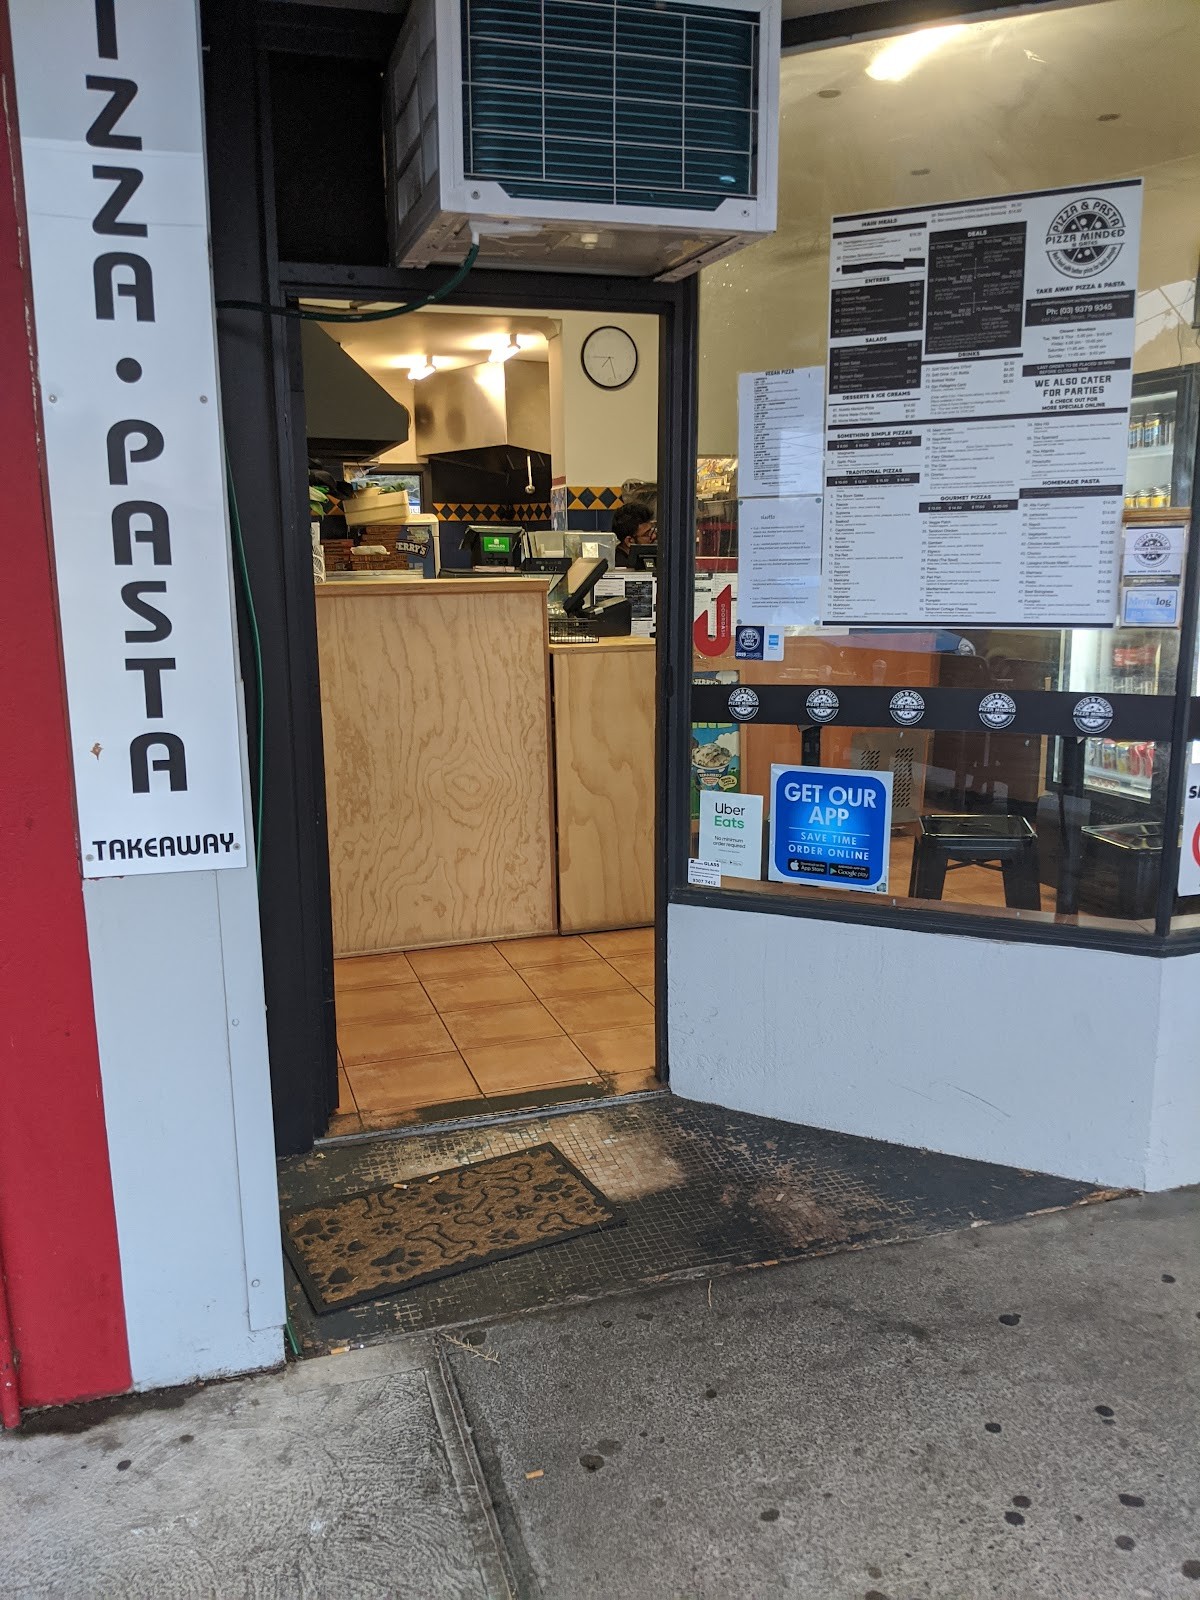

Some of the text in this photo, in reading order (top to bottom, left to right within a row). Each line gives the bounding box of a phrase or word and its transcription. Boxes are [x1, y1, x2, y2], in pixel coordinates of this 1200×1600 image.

[1052, 205, 1078, 233] PIZZA
[1081, 201, 1089, 211] &
[1092, 201, 1120, 227] PASTA
[967, 230, 988, 238] DEALS
[1045, 229, 1125, 245] PIZZA MINDED
[1060, 307, 1074, 316] (03)
[1074, 304, 1093, 313] 9379
[1094, 303, 1112, 312] 9345
[1035, 375, 1112, 388] WE ALSO CATER
[1043, 386, 1104, 397] FOR PARTIES
[106, 418, 188, 794] PASTA
[784, 782, 877, 808] GET OUR
[715, 802, 746, 816] Uber
[808, 806, 850, 826] APP
[714, 816, 745, 829] Eats
[800, 832, 857, 846] SAVE TIME
[92, 832, 234, 861] TAKEAWAY
[788, 844, 869, 861] ORDER ONLINE
[838, 869, 858, 877] Google
